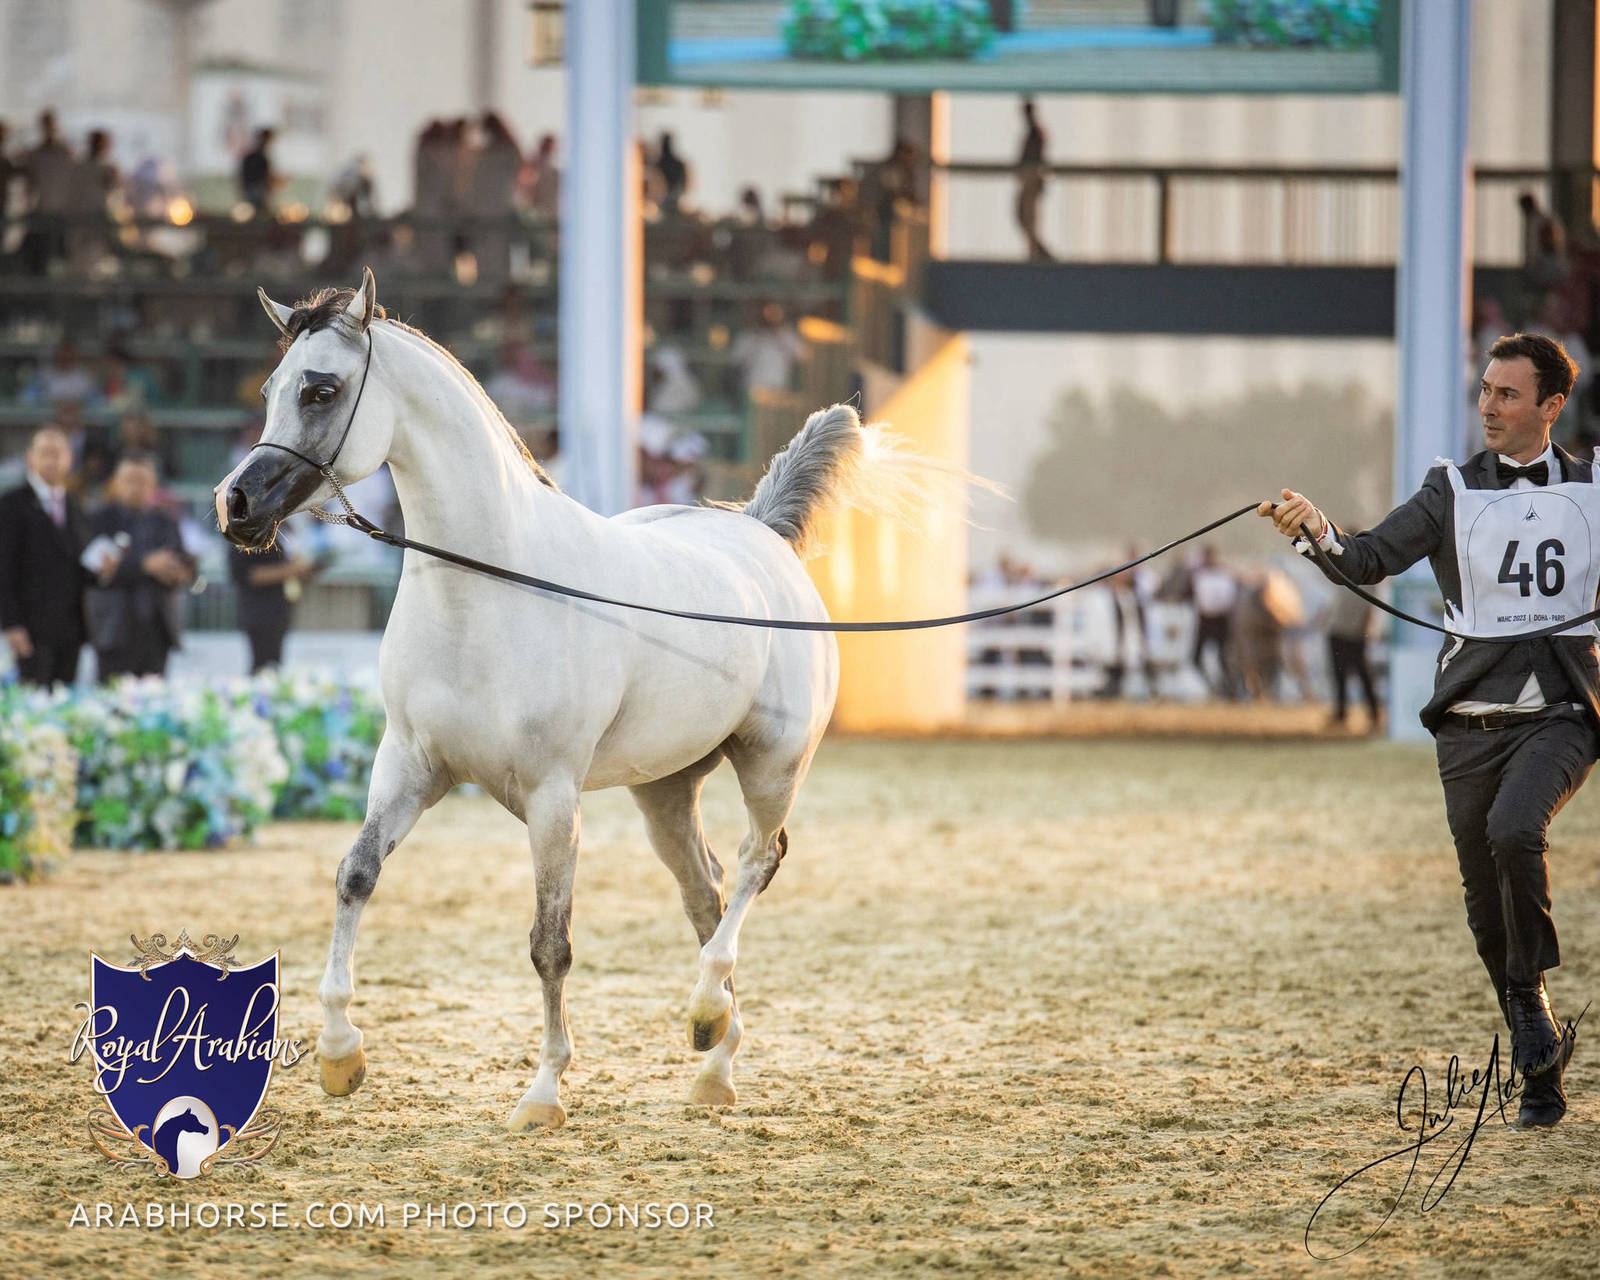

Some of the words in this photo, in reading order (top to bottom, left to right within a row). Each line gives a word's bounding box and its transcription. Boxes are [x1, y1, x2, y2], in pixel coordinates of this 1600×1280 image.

[1497, 538, 1566, 597] 46
[1512, 614, 1527, 622] 2023
[1533, 614, 1549, 622] DOHA
[1551, 614, 1566, 622] PARIS
